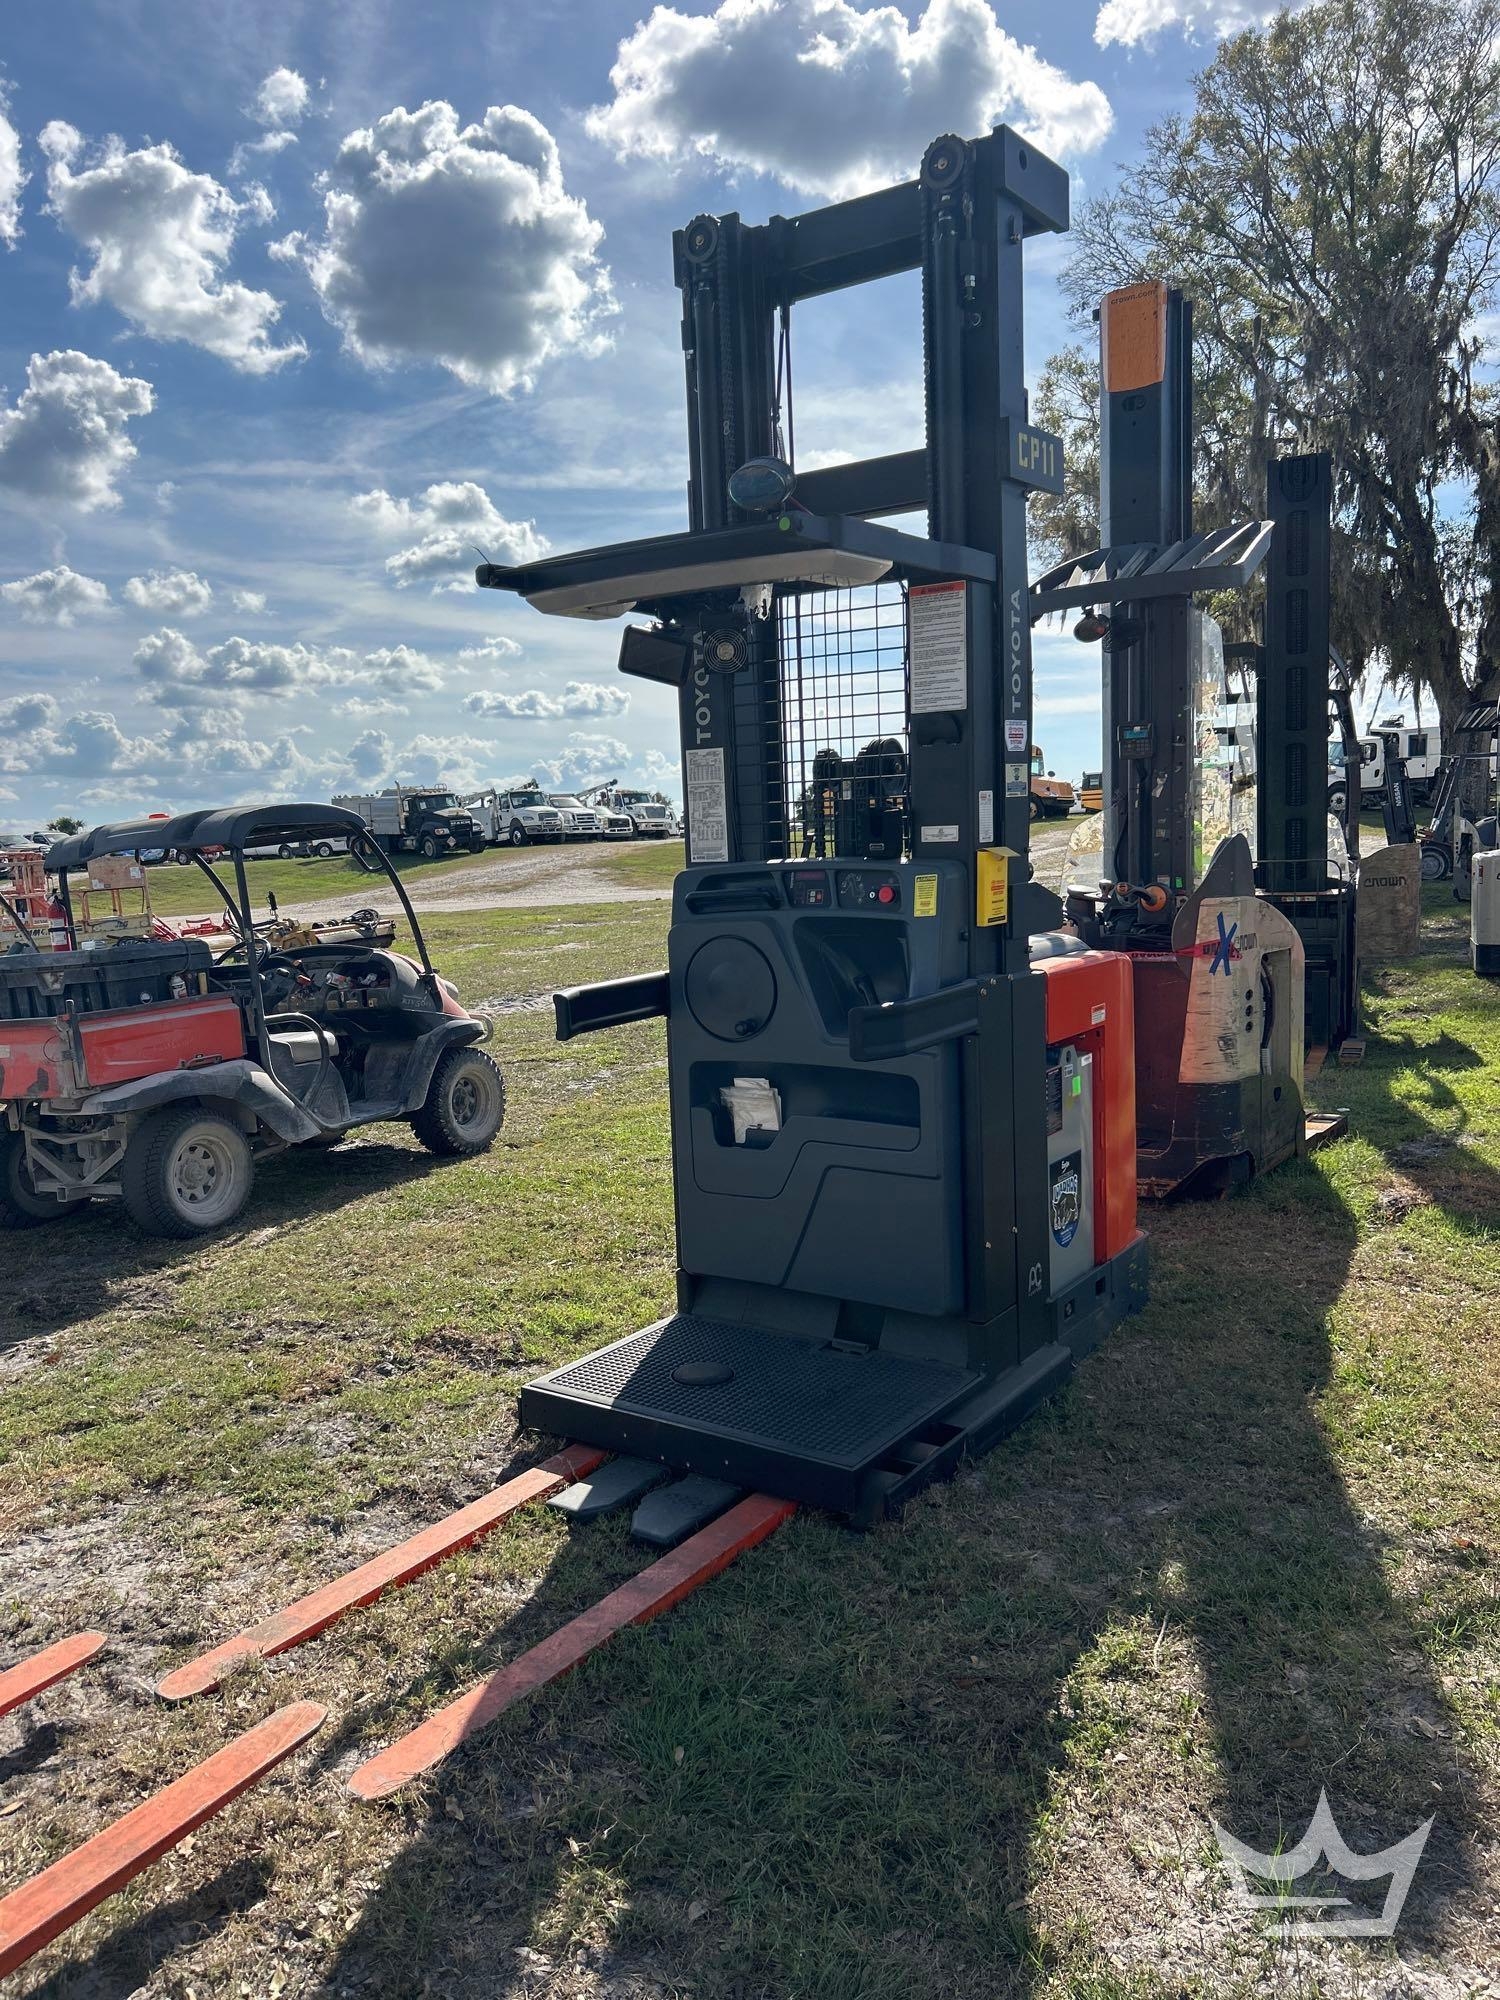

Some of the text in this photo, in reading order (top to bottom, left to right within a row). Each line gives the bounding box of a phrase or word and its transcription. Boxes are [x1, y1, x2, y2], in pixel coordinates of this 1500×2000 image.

[1018, 432, 1054, 477] CP11
[1011, 589, 1021, 713] TOYOTA
[1393, 782, 1402, 807] NISSAN
